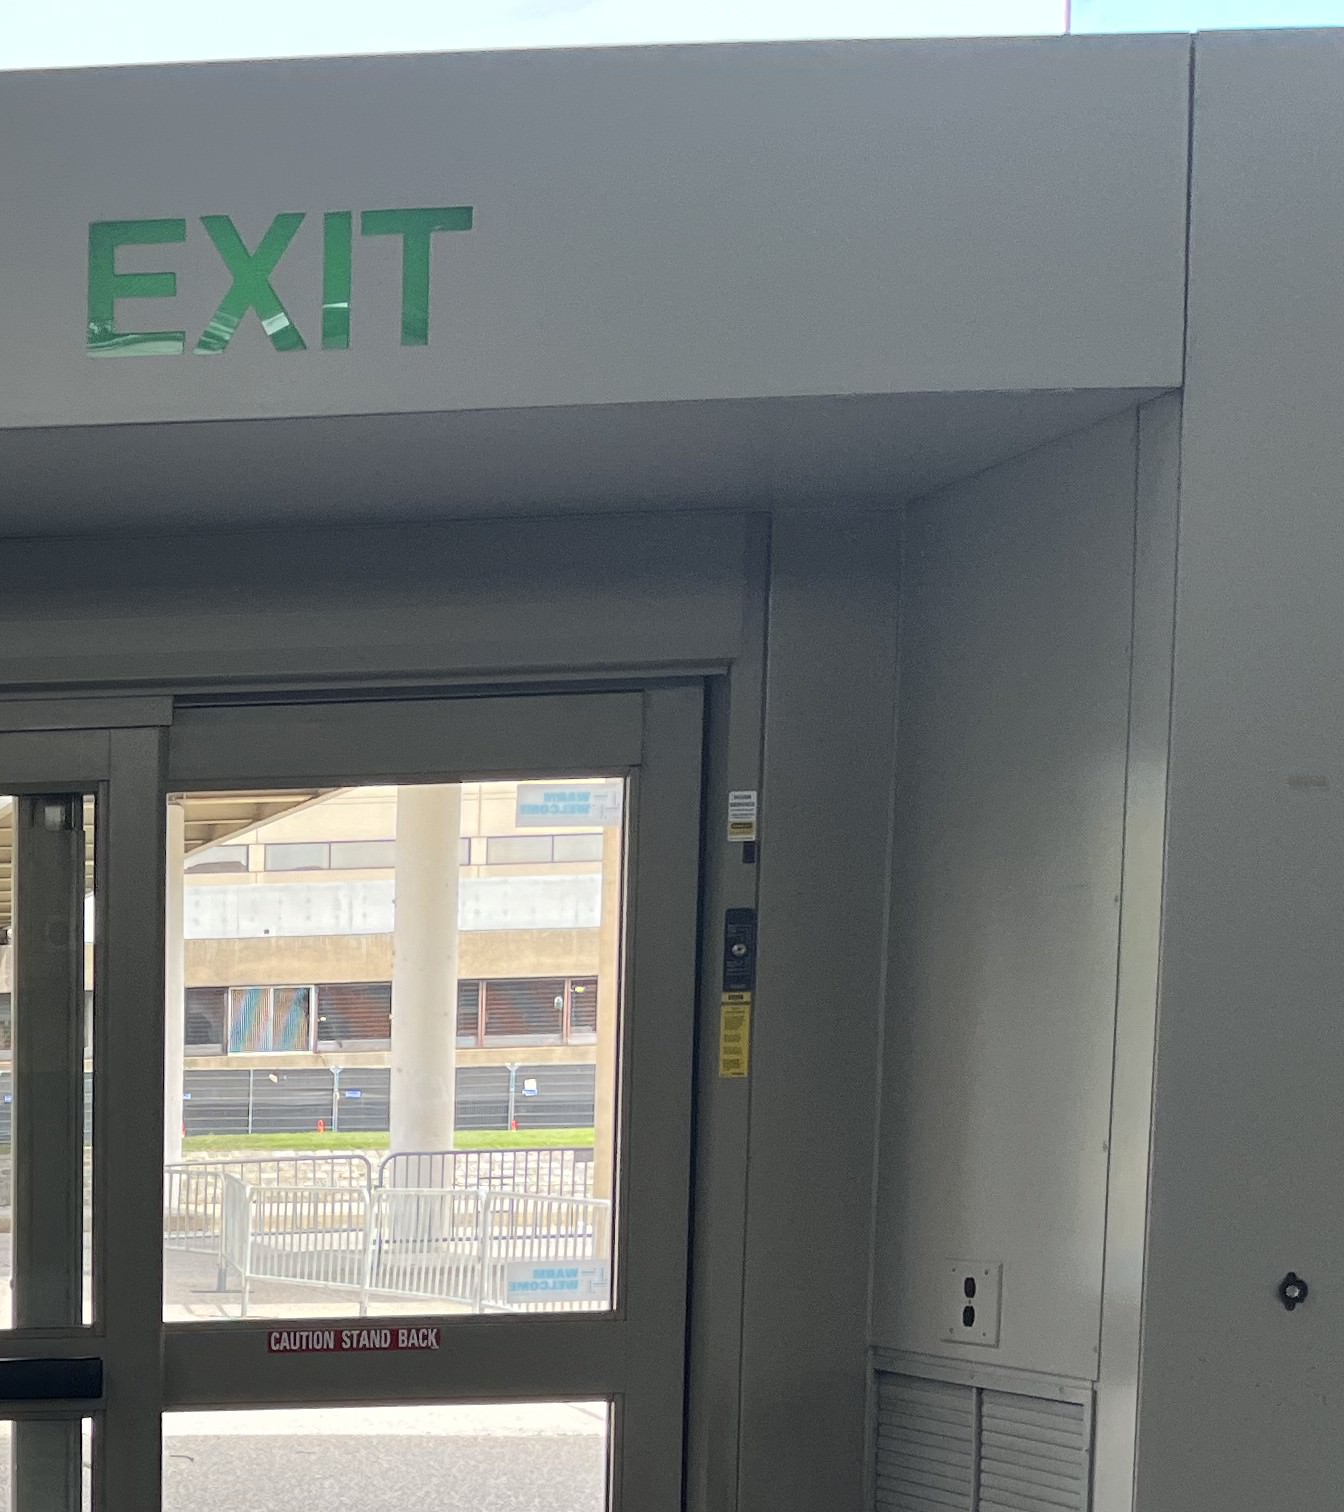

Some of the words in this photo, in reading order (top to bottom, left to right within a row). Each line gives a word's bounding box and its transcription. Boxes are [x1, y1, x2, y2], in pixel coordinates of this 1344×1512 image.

[86, 206, 473, 358] EXIT
[270, 1331, 335, 1351] CAUTION
[341, 1329, 391, 1349] STAND
[398, 1328, 439, 1349] BACK
